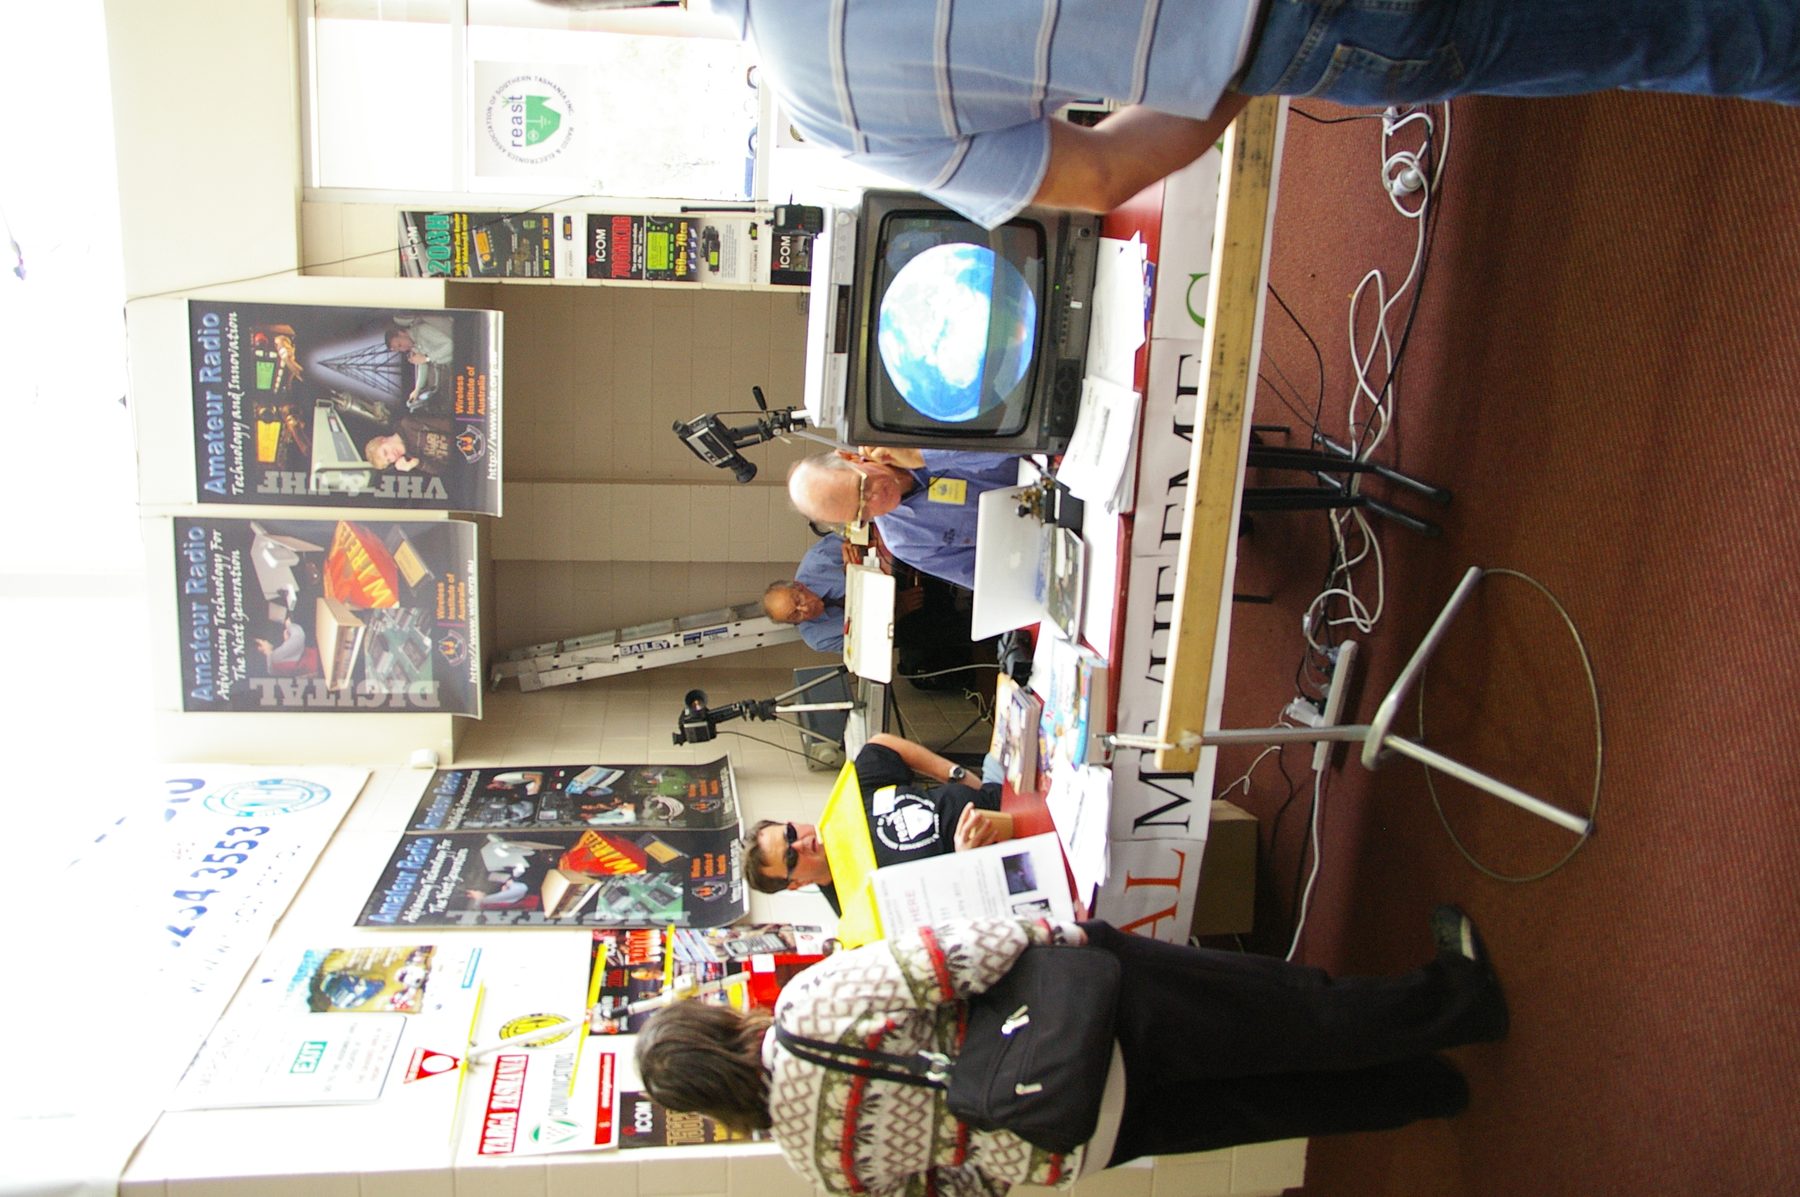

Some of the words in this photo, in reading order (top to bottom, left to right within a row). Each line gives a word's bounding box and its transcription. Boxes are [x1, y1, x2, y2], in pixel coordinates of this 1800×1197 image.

[489, 95, 497, 105] OF
[486, 106, 507, 153] ASSOCIATION
[507, 94, 523, 148] reast
[407, 226, 418, 260] ICOM
[424, 214, 451, 274] 208H
[595, 228, 607, 263] ICOM
[779, 236, 791, 268] ICOM
[198, 312, 222, 383] Radio
[225, 312, 241, 390] Innovation
[466, 366, 475, 377] of
[227, 391, 245, 419] and
[456, 375, 464, 414] Wireless
[467, 378, 475, 414] Institute
[477, 374, 486, 415] Australia
[204, 390, 227, 495] Amateur
[230, 421, 250, 495] Technology
[374, 474, 448, 499] VHF
[210, 529, 223, 551] For
[183, 526, 208, 594] Radio
[446, 573, 455, 584] of
[211, 553, 231, 626] Technology
[229, 549, 249, 622] Generation
[437, 582, 445, 620] Wireless
[447, 585, 455, 620] Institute
[458, 581, 466, 620] Australia
[189, 602, 213, 701] Amateur
[231, 623, 245, 655] Next
[215, 629, 233, 700] Advancing
[232, 660, 246, 681] The
[249, 678, 440, 707] DIGITAL
[190, 827, 271, 880] 3553
[368, 870, 419, 923] Amateur
[396, 837, 435, 870] Radio
[292, 1042, 326, 1072] EXIT
[489, 1055, 527, 1110] TASMANIA
[482, 1111, 517, 1154] TARGA
[635, 1102, 653, 1132] ICOM
